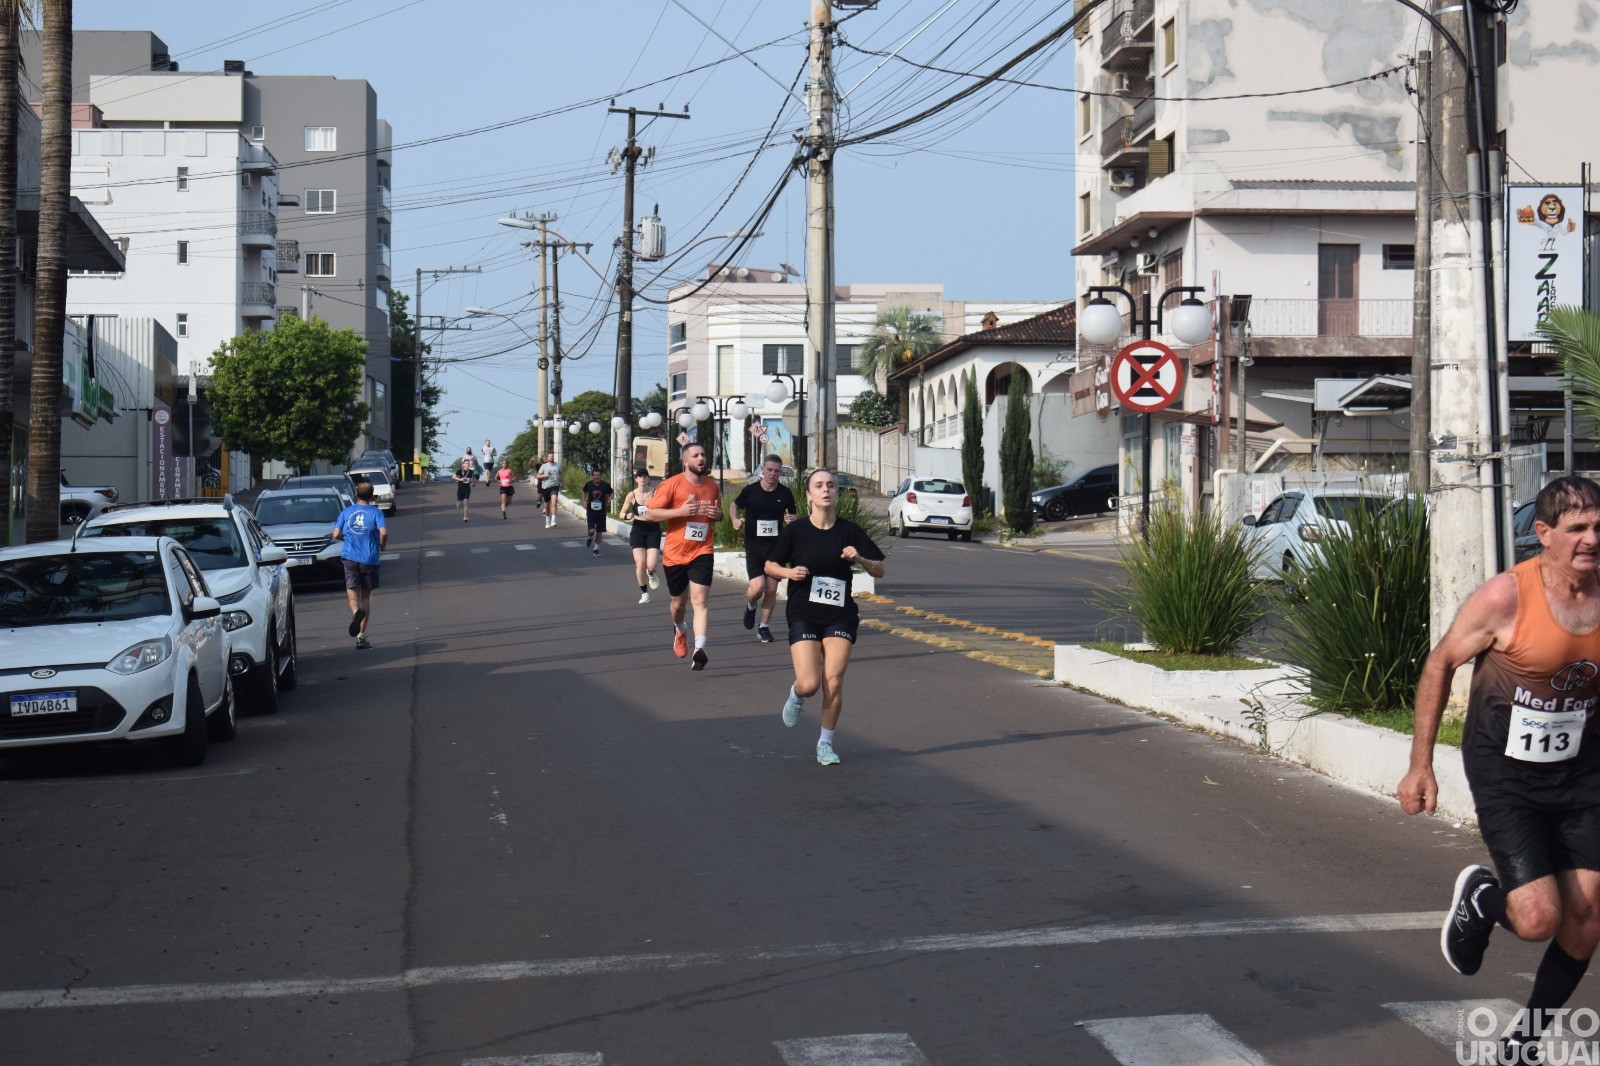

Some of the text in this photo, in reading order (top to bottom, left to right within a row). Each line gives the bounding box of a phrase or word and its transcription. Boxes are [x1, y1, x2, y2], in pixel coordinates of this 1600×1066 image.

[691, 530, 703, 538] 20
[816, 588, 841, 601] 162
[1514, 686, 1557, 711] Med
[17, 699, 70, 714] IVD4B61
[1520, 732, 1570, 753] 113
